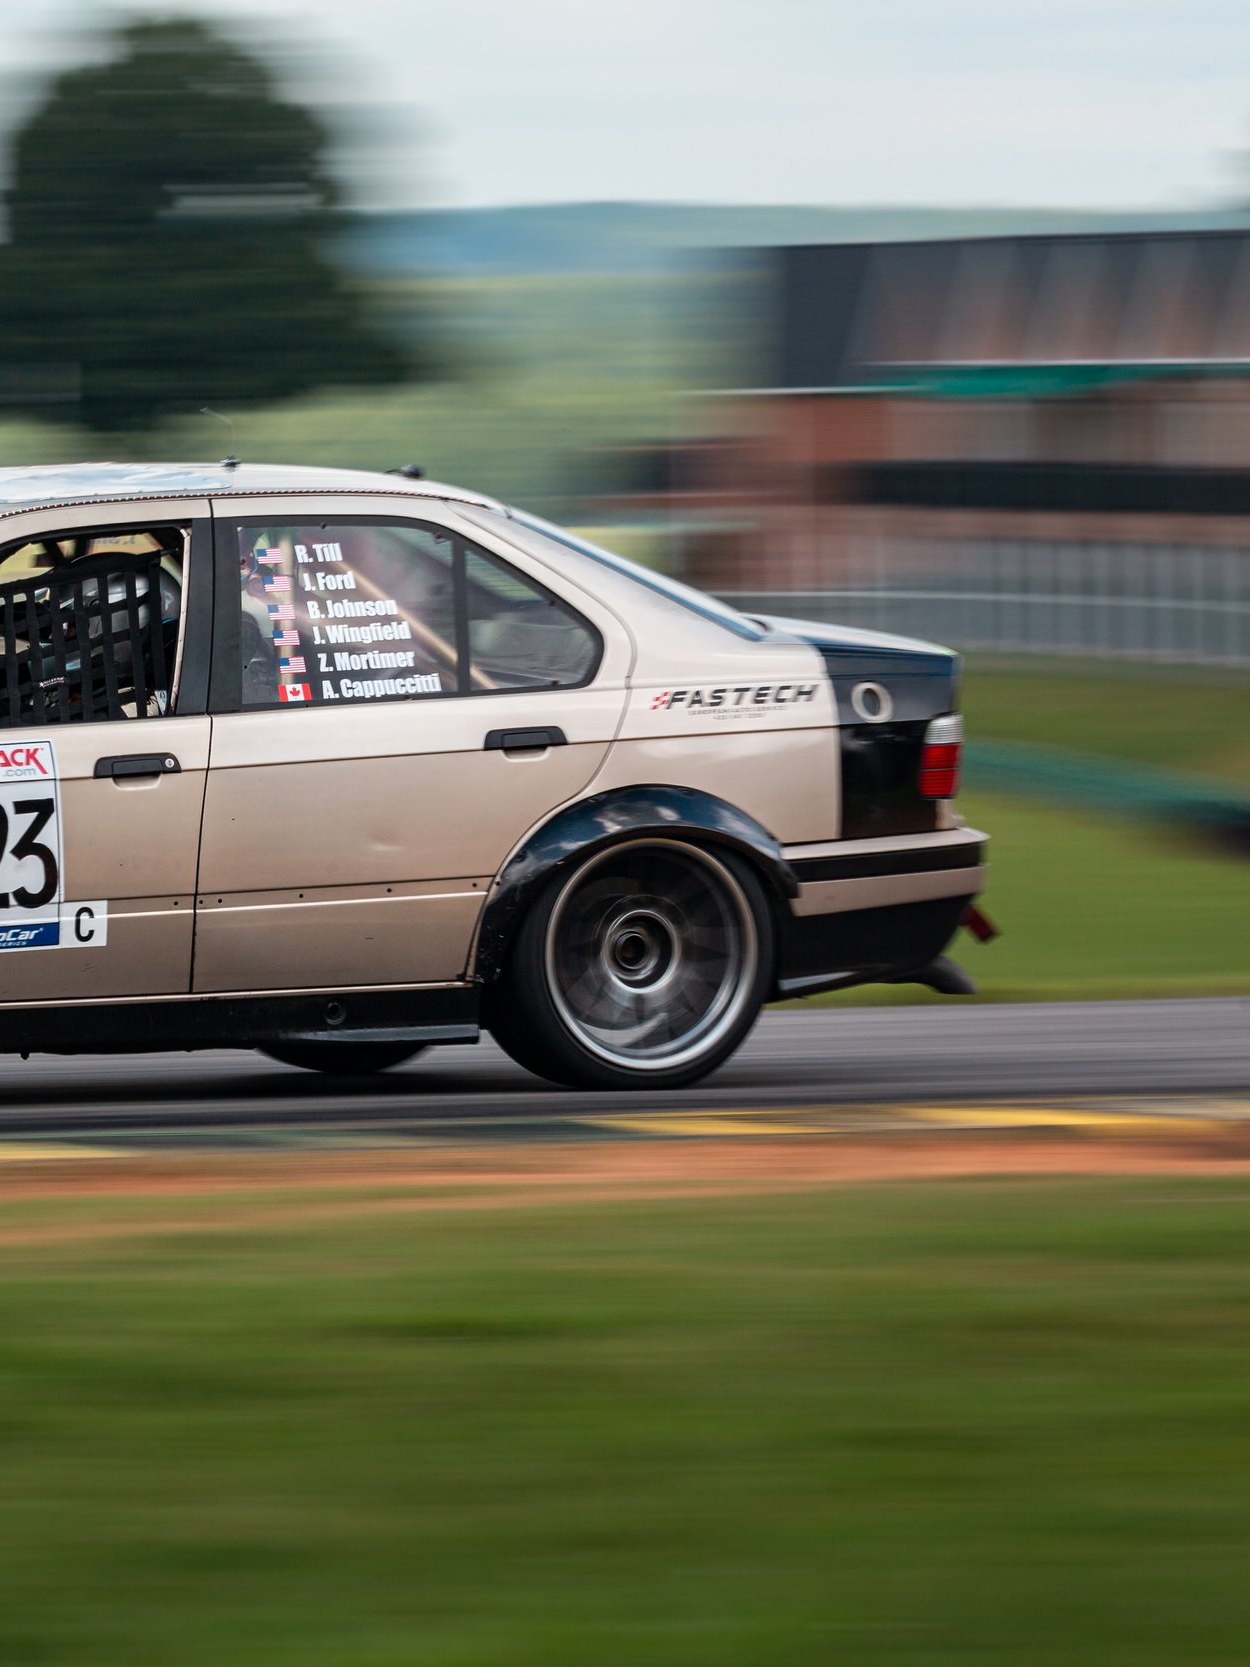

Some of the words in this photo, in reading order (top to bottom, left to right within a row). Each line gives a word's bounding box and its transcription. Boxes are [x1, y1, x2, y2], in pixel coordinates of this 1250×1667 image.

[294, 544, 314, 563] R.
[312, 542, 343, 562] Till
[303, 572, 316, 592] J.
[316, 570, 356, 591] Ford
[307, 600, 326, 619] B.
[326, 599, 399, 619] Johnson
[312, 625, 326, 645] J.
[325, 621, 412, 644] Wingfield
[317, 653, 334, 672] Z.
[333, 650, 415, 671] Mortimer
[322, 680, 339, 699] A.
[340, 673, 442, 698] Cappuccitti
[665, 684, 820, 710] FASTECH
[2, 767, 37, 778] .com
[75, 906, 95, 943] C
